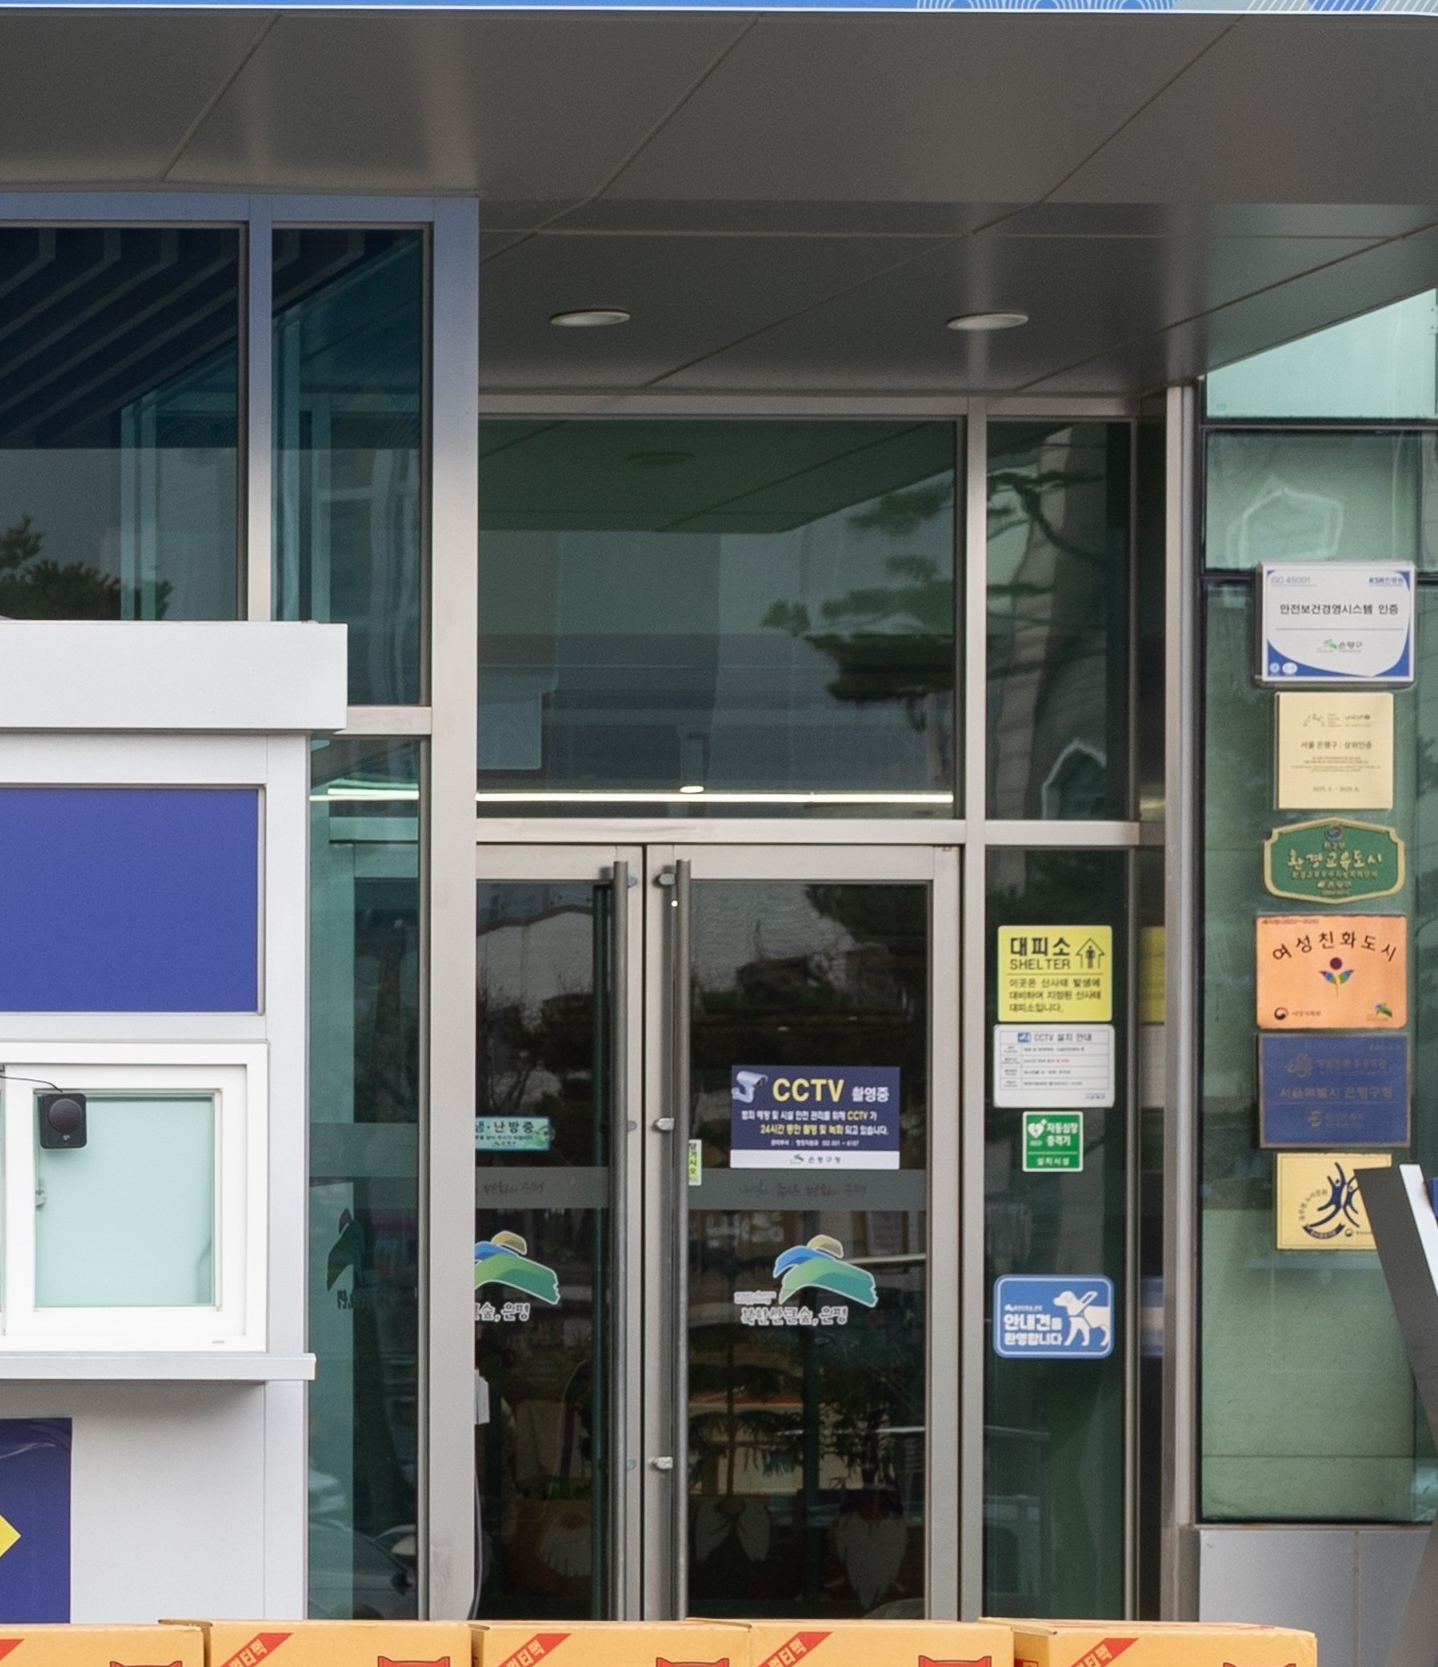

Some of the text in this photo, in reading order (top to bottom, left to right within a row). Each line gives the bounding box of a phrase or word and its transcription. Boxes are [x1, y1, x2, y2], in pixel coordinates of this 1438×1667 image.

[1280, 603, 1399, 615] 안전보건경영시스템 인증
[1288, 849, 1383, 870] 환경교육도시
[1010, 937, 1071, 956] 대피소
[1272, 931, 1397, 962] 여성친화도시
[1010, 958, 1071, 970] SHELTER
[1009, 978, 1036, 988] 이곳은
[1041, 978, 1068, 988] 산사태
[1034, 1033, 1054, 1041] CCTV
[772, 1078, 890, 1103] CCTV 촬영중
[847, 1110, 868, 1121] CCTV
[501, 1302, 531, 1321] 은평
[741, 1306, 848, 1326] 북한산큰숲, 은평
[1004, 1314, 1062, 1331] 안내견을
